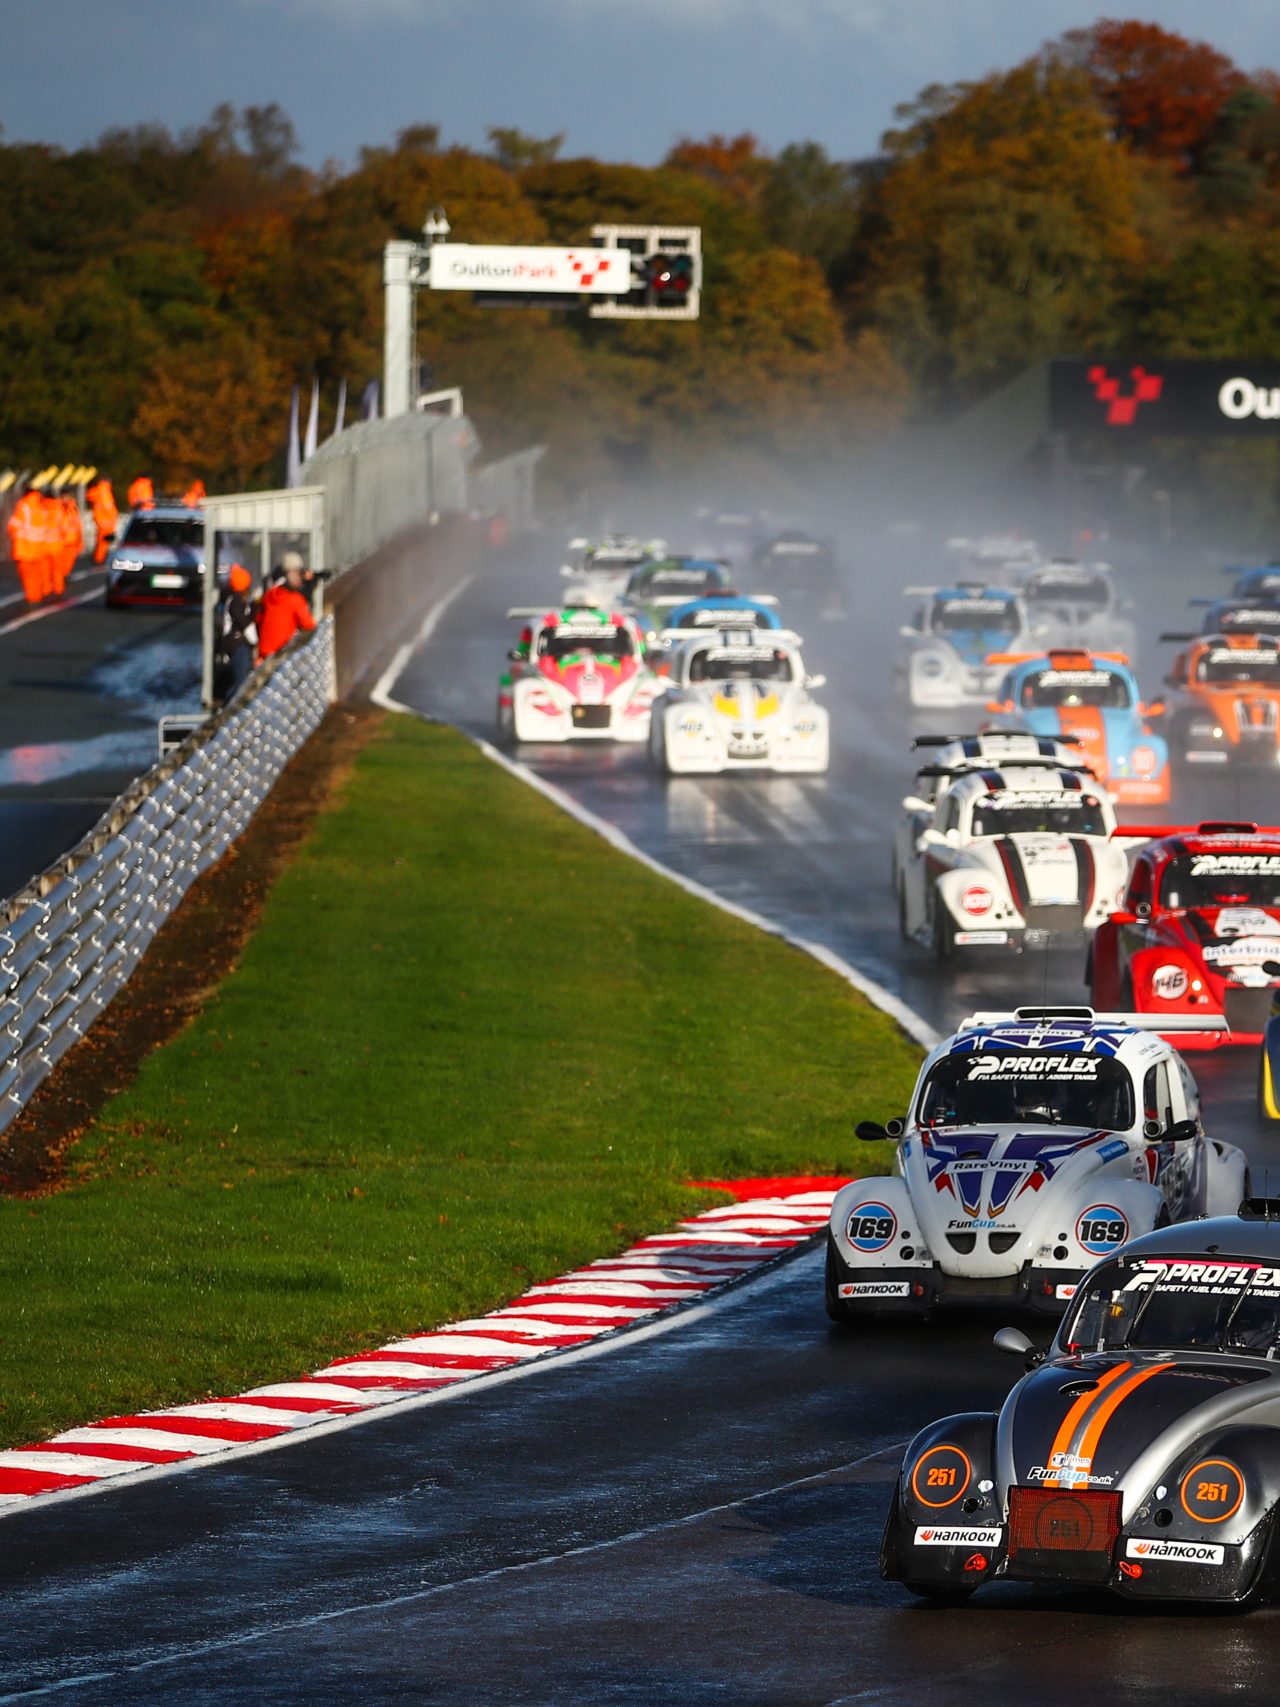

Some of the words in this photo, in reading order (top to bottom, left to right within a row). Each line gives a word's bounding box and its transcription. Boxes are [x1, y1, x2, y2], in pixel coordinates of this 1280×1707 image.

[1000, 1057, 1102, 1073] PROFLEX
[953, 1161, 1029, 1171] RareVinyl
[849, 1216, 895, 1239] 169
[947, 1219, 1017, 1231] FunCup.co.uk
[1079, 1220, 1126, 1243] 169
[1252, 1288, 1280, 1298] TANKS
[928, 1467, 957, 1487] 251
[1027, 1466, 1115, 1485] FunCup.co.uk
[1196, 1482, 1230, 1502] 251
